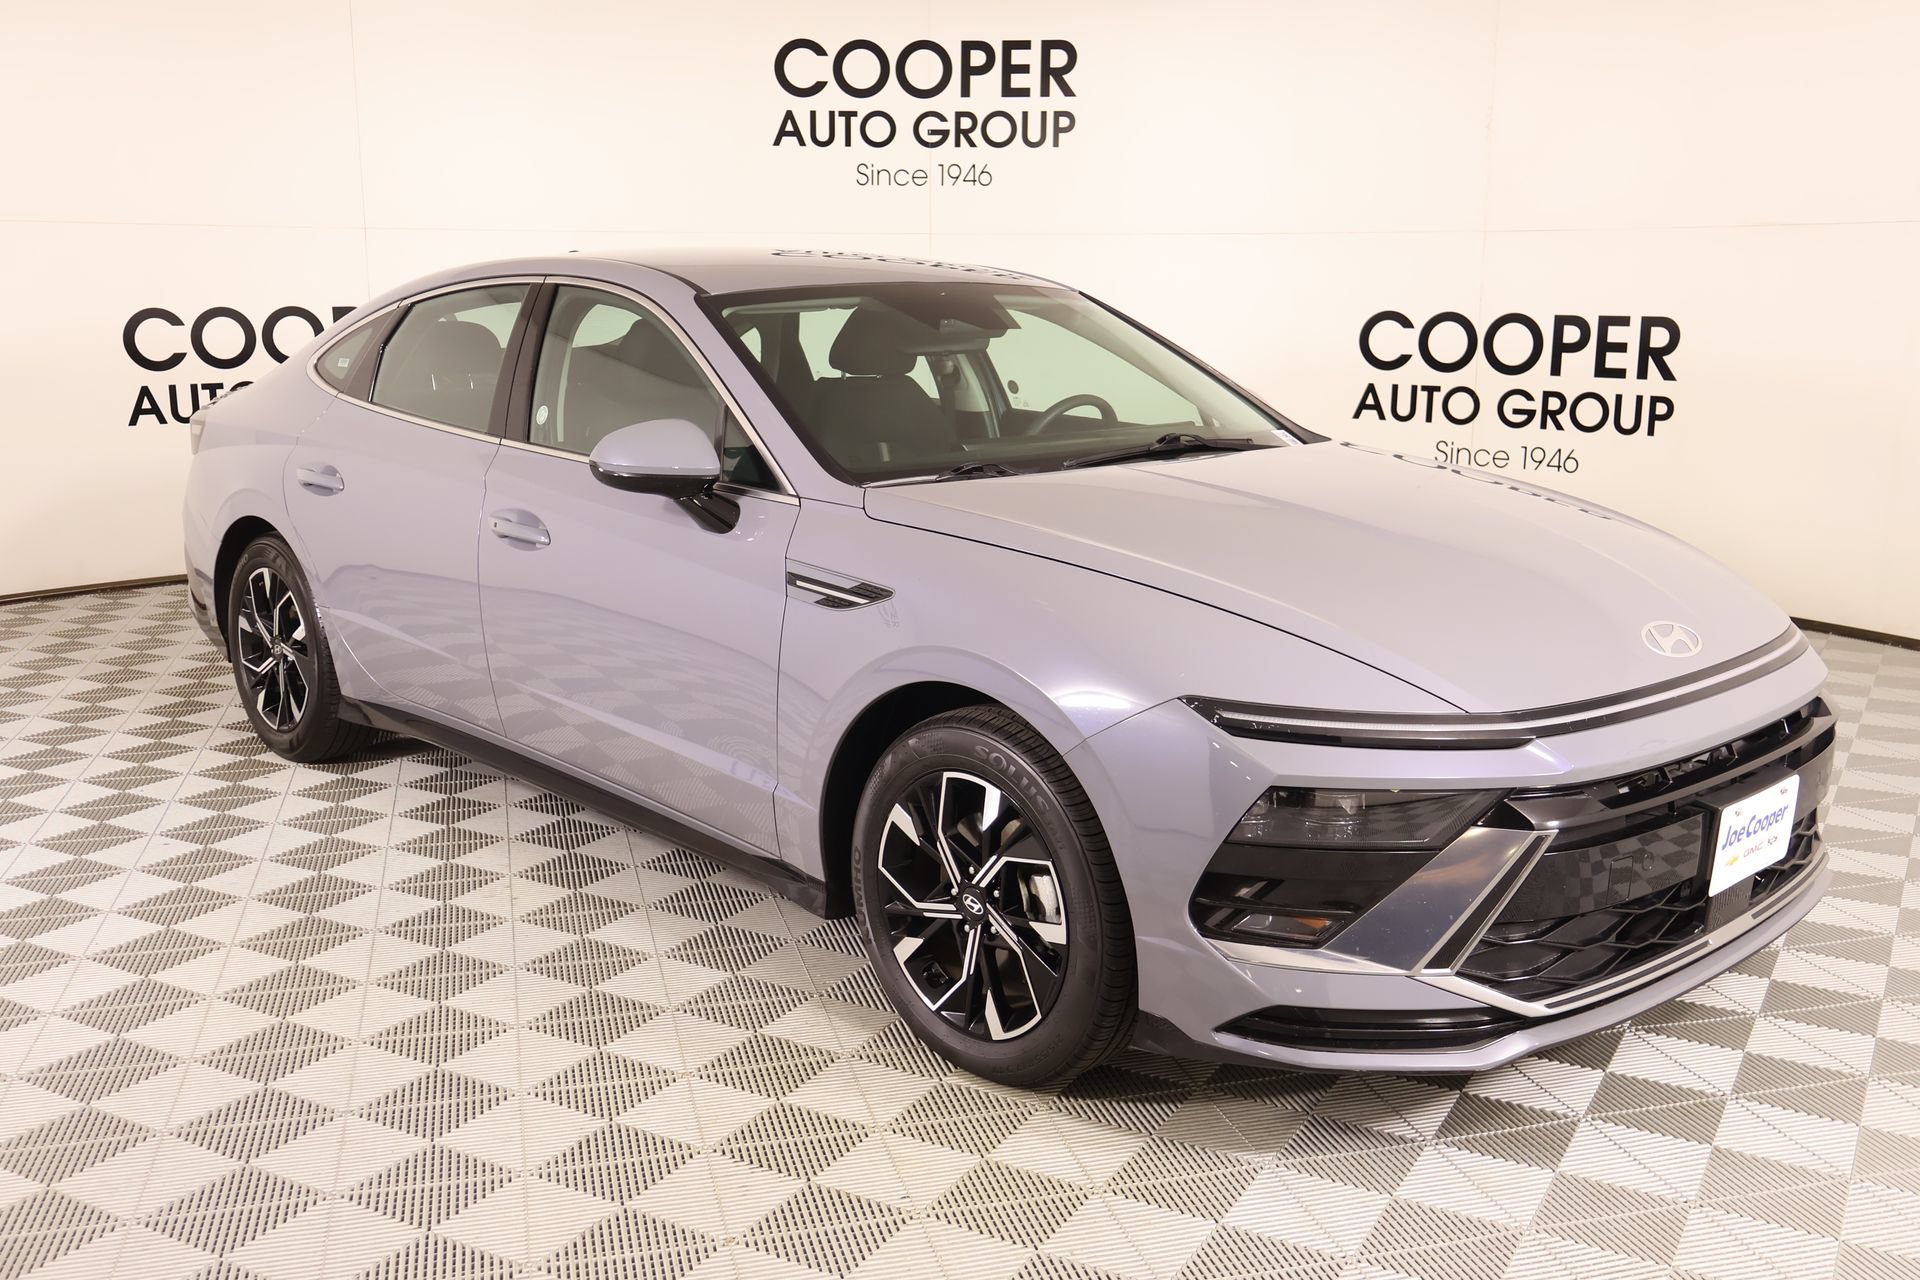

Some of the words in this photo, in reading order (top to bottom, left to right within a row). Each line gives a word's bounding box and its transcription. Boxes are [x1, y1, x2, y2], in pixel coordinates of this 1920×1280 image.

[773, 38, 1078, 99] COOPER
[772, 109, 897, 148] AUTO
[912, 110, 1076, 149] GROUP
[856, 162, 929, 187] Since
[937, 163, 993, 187] 1946
[122, 306, 358, 372] COO
[1358, 310, 1681, 382] COOPER
[127, 380, 255, 427] AUT
[1352, 382, 1481, 426] AUTO
[1496, 388, 1675, 437] GROUP
[1434, 440, 1510, 469] Since
[1521, 445, 1580, 474] 1946
